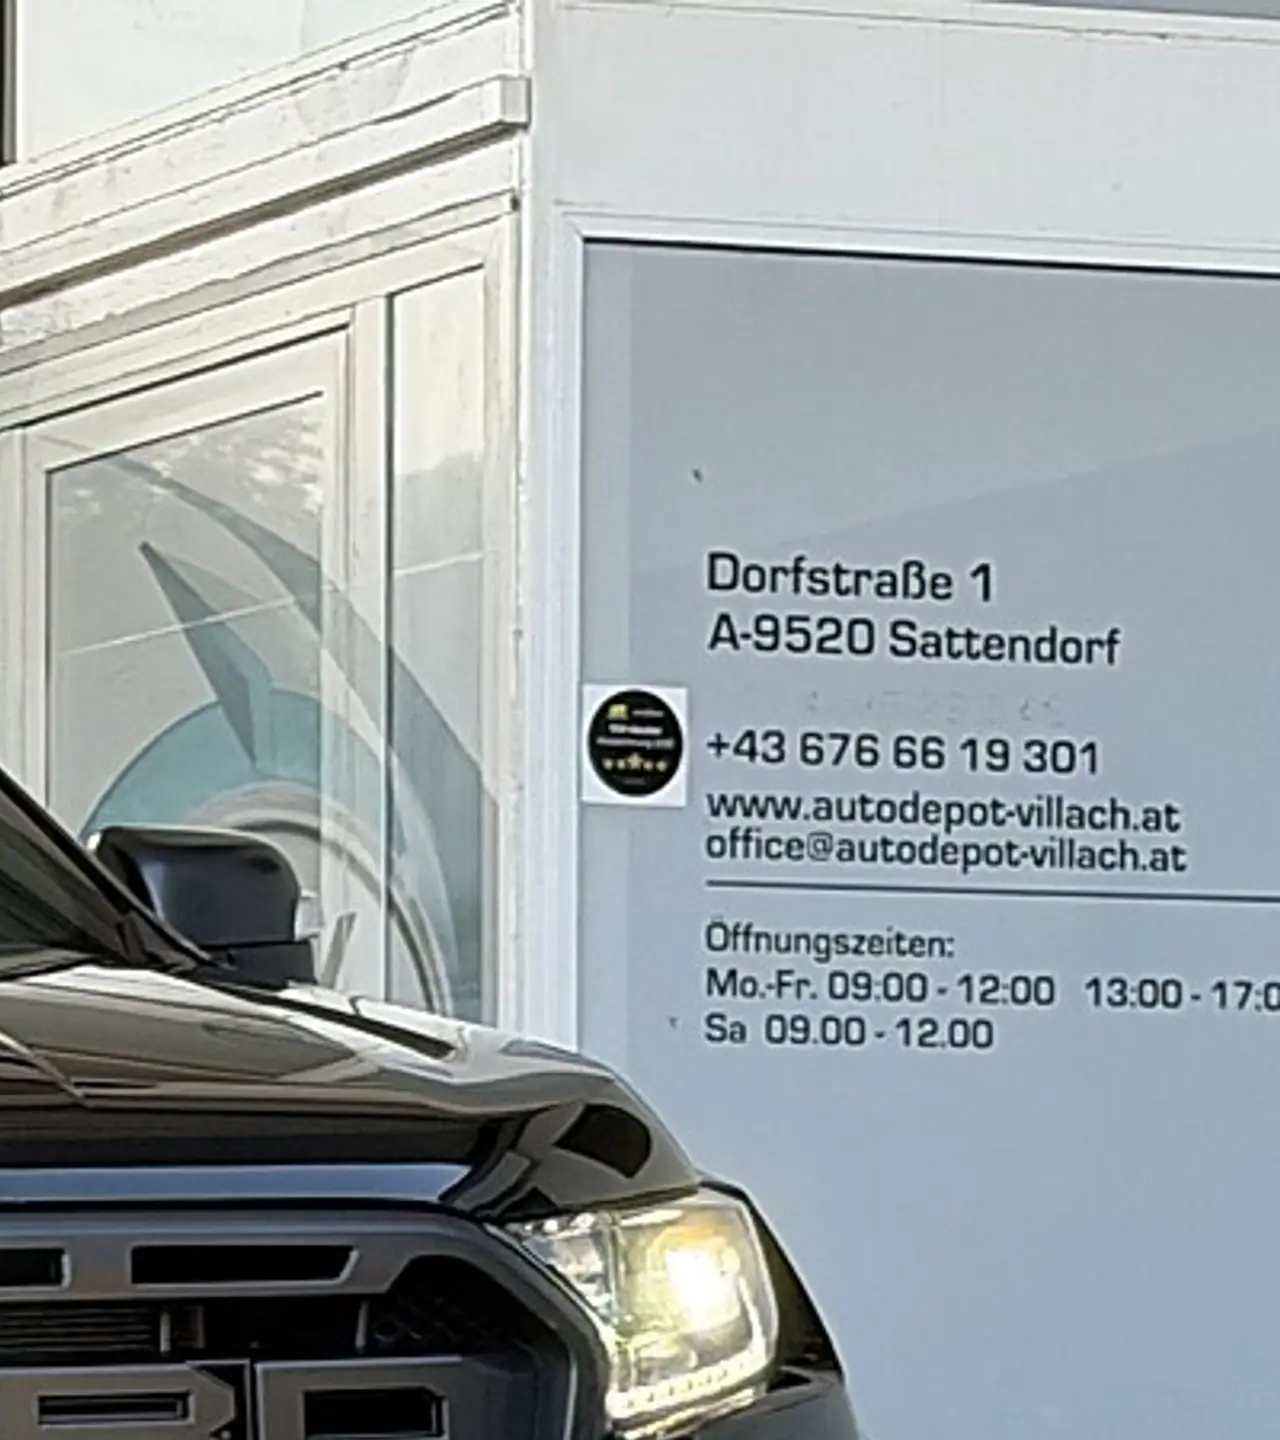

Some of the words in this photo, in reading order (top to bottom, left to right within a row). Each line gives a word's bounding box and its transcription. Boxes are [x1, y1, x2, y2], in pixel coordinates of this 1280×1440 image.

[707, 550, 954, 602] Dorfstraße
[970, 562, 992, 603] 1
[707, 611, 876, 656] A-9520
[888, 618, 1121, 666] Sattendorf
[705, 728, 787, 765] +43
[799, 731, 881, 768] 676
[892, 735, 946, 771] 66
[959, 737, 1011, 773] 19
[1022, 738, 1099, 776] 301
[705, 789, 1182, 834] www.autodepot-villach.at
[705, 827, 1188, 876] office@autodepot-villach.at
[705, 920, 955, 963] Öffnungszeiten:
[706, 967, 819, 1001] Mo.-Fr.
[827, 970, 929, 1004] 09:00
[956, 974, 1056, 1007] 12:00
[1085, 976, 1183, 1010] 13:00
[705, 1011, 748, 1044] Sa
[764, 1013, 867, 1047] 09.00
[896, 1017, 995, 1050] 12.00
